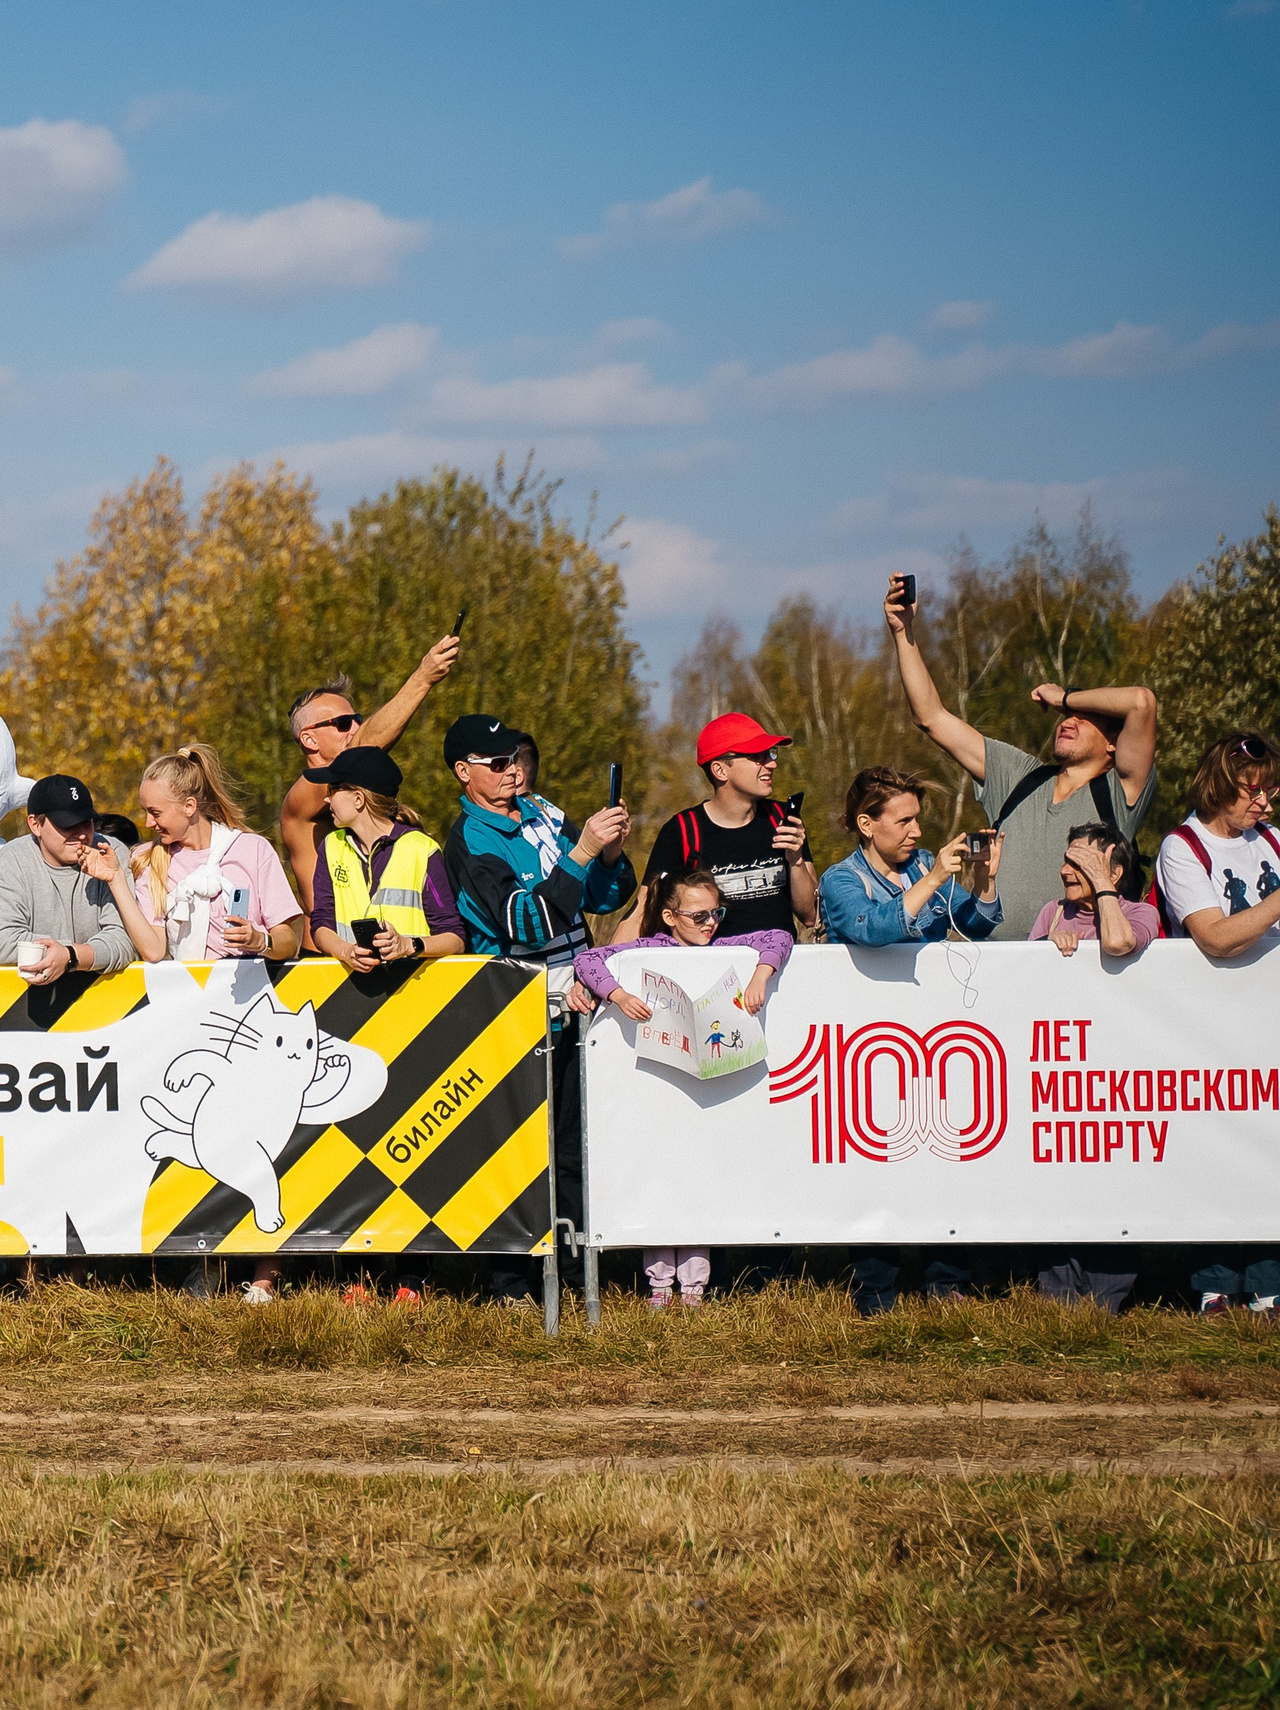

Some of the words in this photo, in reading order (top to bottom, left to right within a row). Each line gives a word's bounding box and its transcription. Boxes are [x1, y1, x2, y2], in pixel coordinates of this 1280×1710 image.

[644, 972, 688, 1005] ПАПА
[645, 991, 686, 1021] НОРД
[1029, 1019, 1092, 1063] ЛЕТ
[769, 1019, 1008, 1164] 100
[1031, 1068, 1280, 1113] МОСКОВСКОМ
[386, 1068, 484, 1164] билайн
[1032, 1120, 1169, 1163] СПОРТУ
